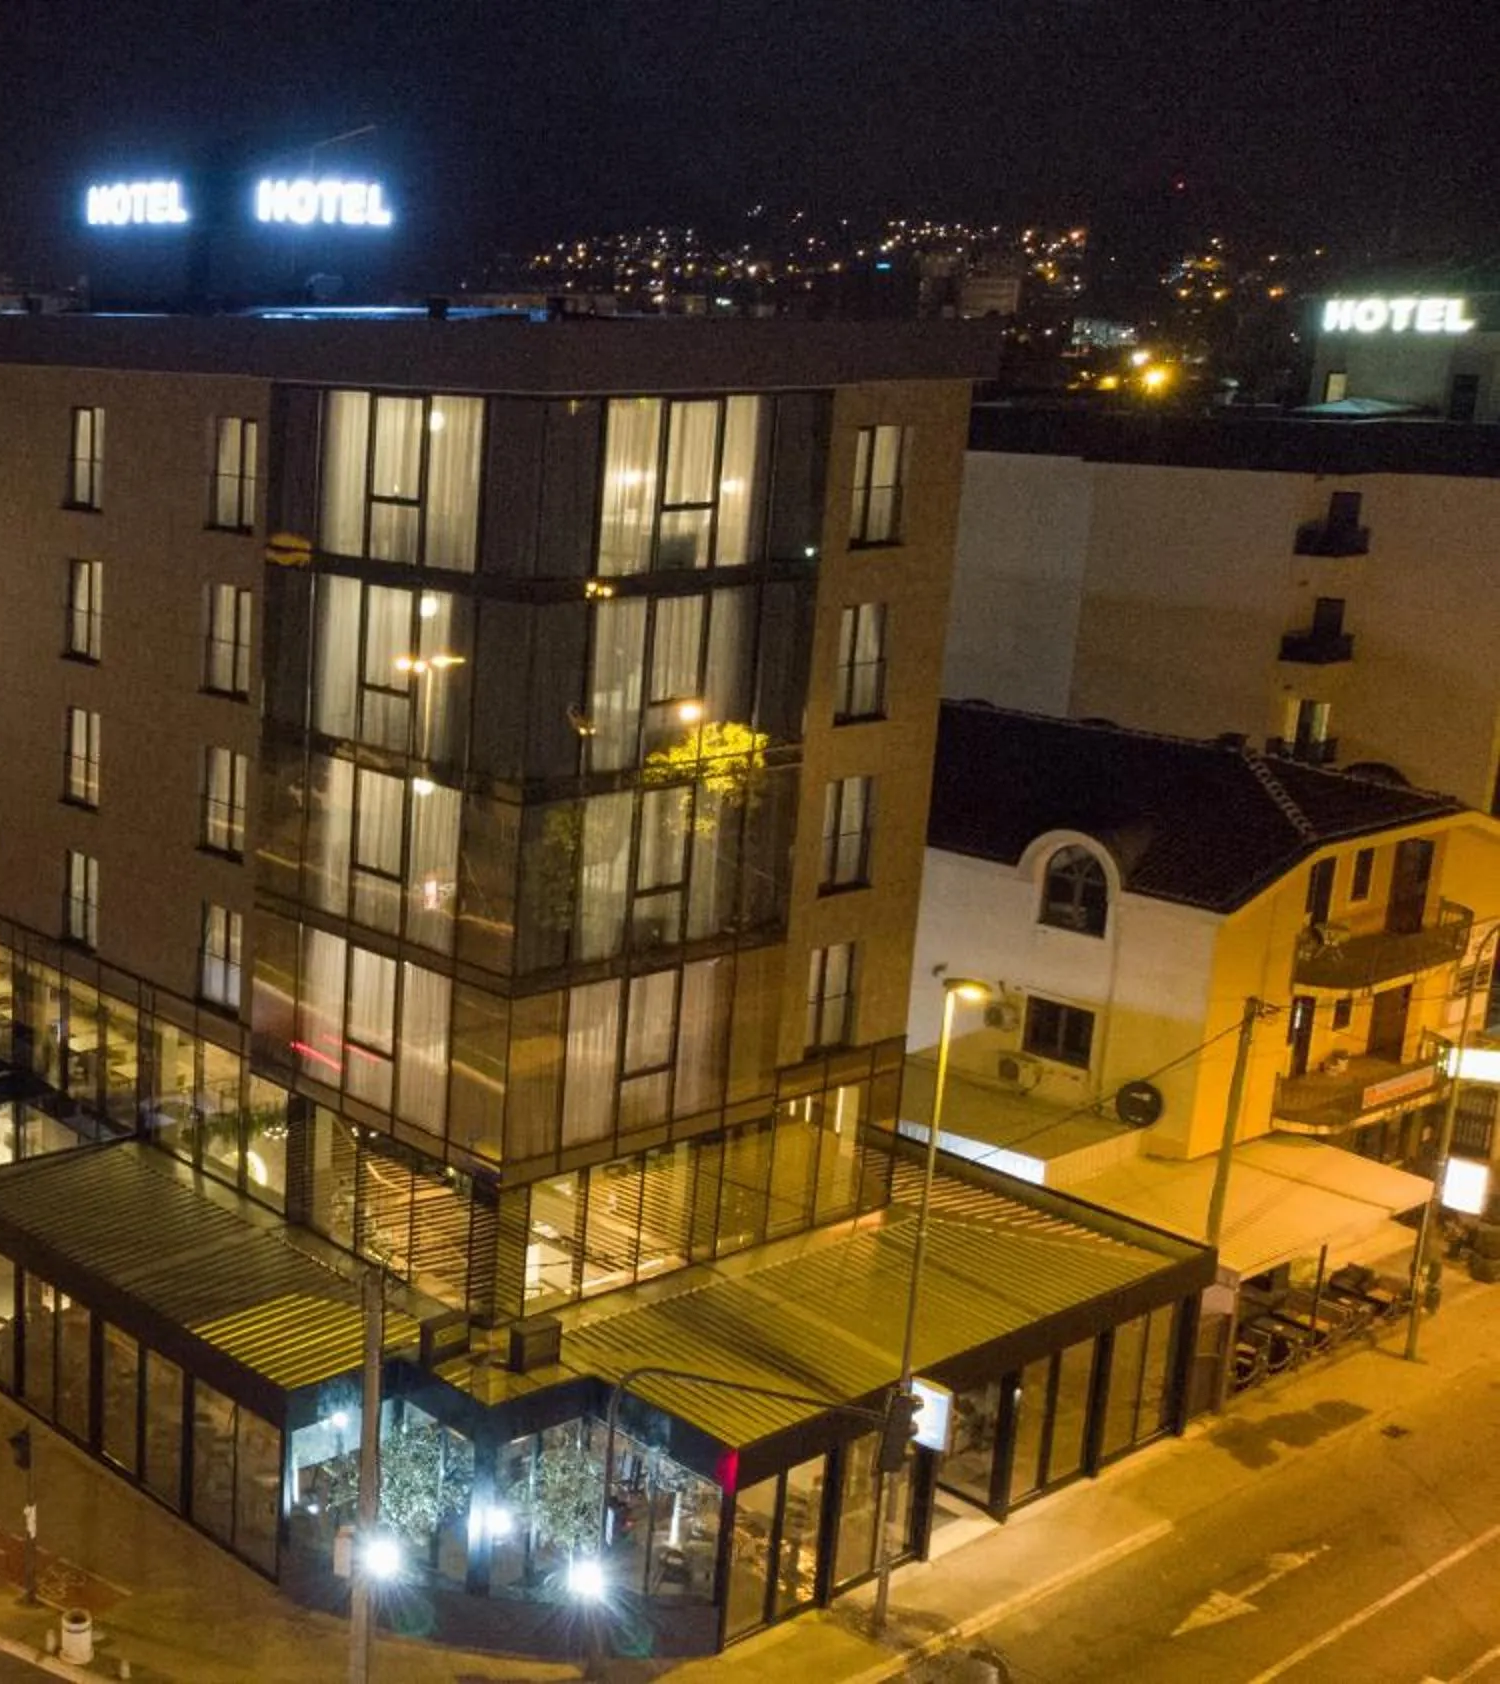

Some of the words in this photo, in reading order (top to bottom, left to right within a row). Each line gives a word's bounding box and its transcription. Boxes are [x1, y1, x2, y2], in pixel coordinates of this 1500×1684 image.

[87, 181, 187, 225] HOTEL
[257, 178, 391, 225] HOTEL
[1323, 297, 1474, 334] HOTEL
